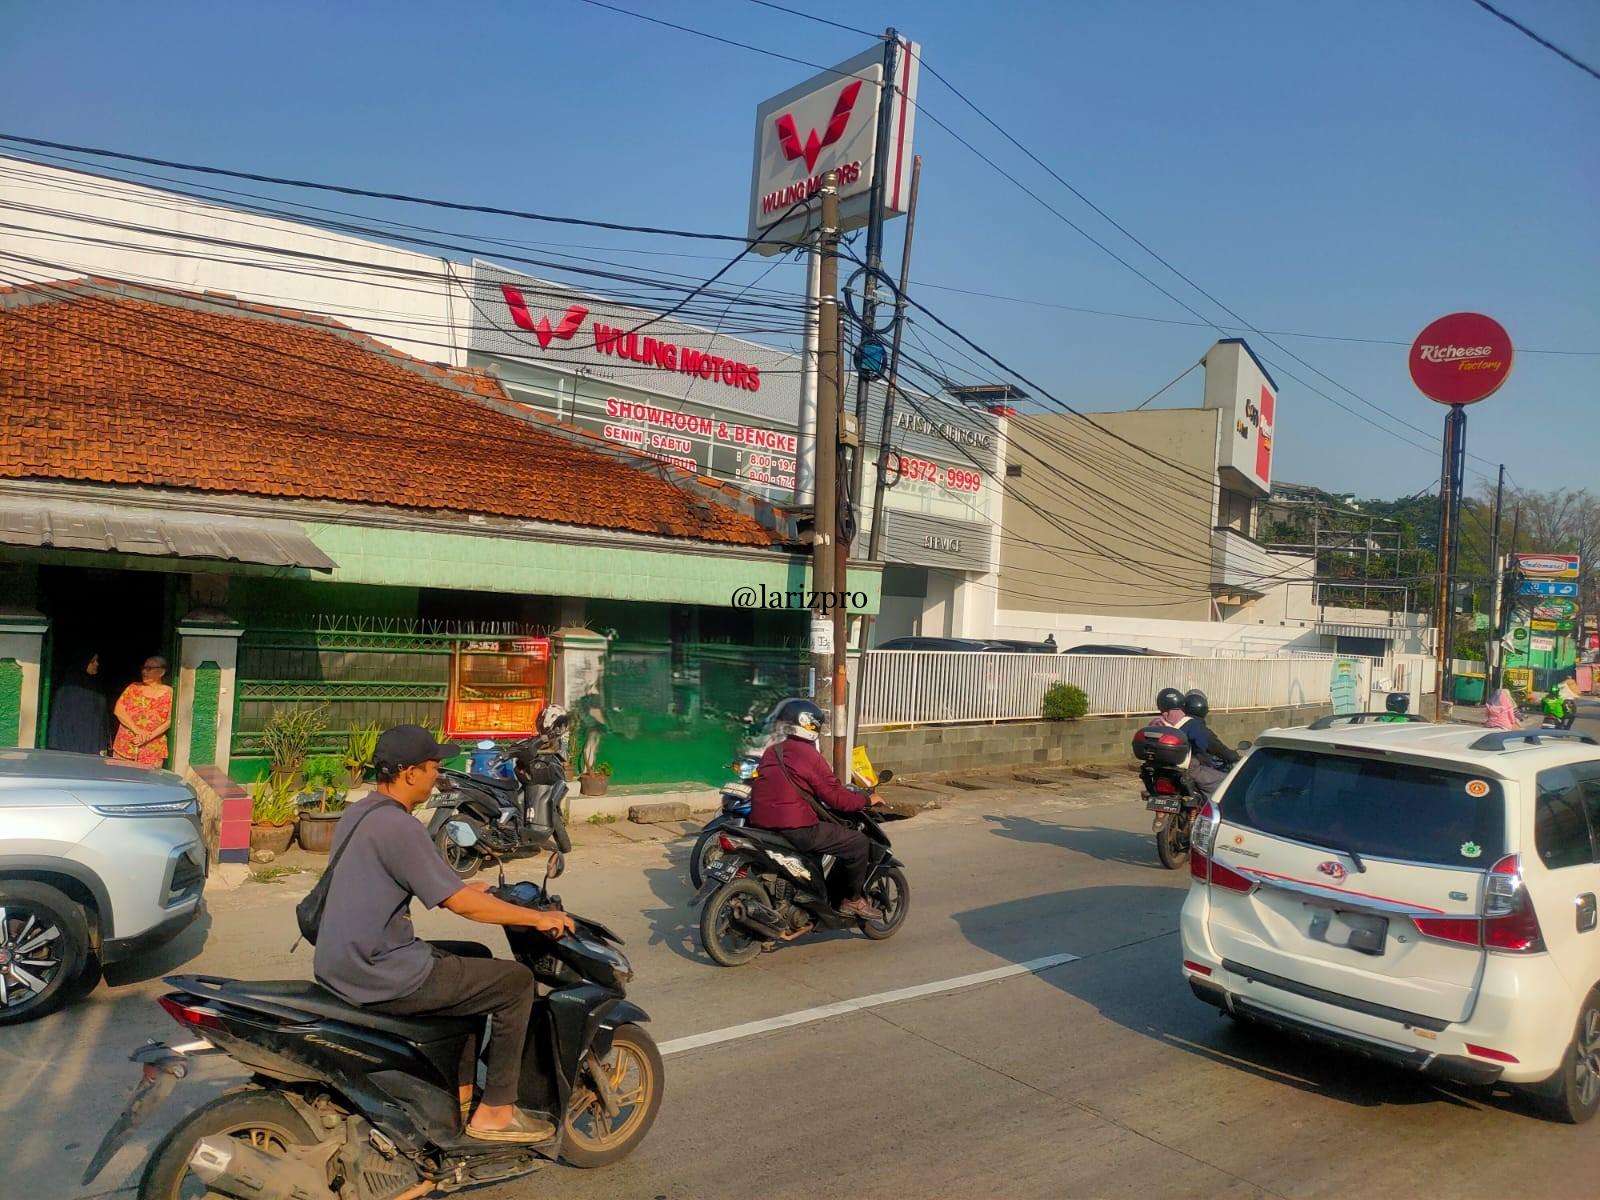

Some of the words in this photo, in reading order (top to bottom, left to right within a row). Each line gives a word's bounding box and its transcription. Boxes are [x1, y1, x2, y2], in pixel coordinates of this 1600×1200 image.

[763, 182, 807, 215] WULING
[807, 161, 861, 196] MOORS
[594, 323, 677, 371] WULING
[681, 347, 760, 392] MOTORS
[1420, 344, 1492, 363] Richeese
[1458, 360, 1501, 371] Factory
[604, 425, 643, 444] SENIN
[652, 434, 691, 453] SABTU
[750, 454, 771, 468] 8.00
[606, 397, 714, 436] SHOWROOM
[717, 422, 729, 440] &
[733, 425, 797, 454] BENGKE
[947, 467, 981, 492] 9999
